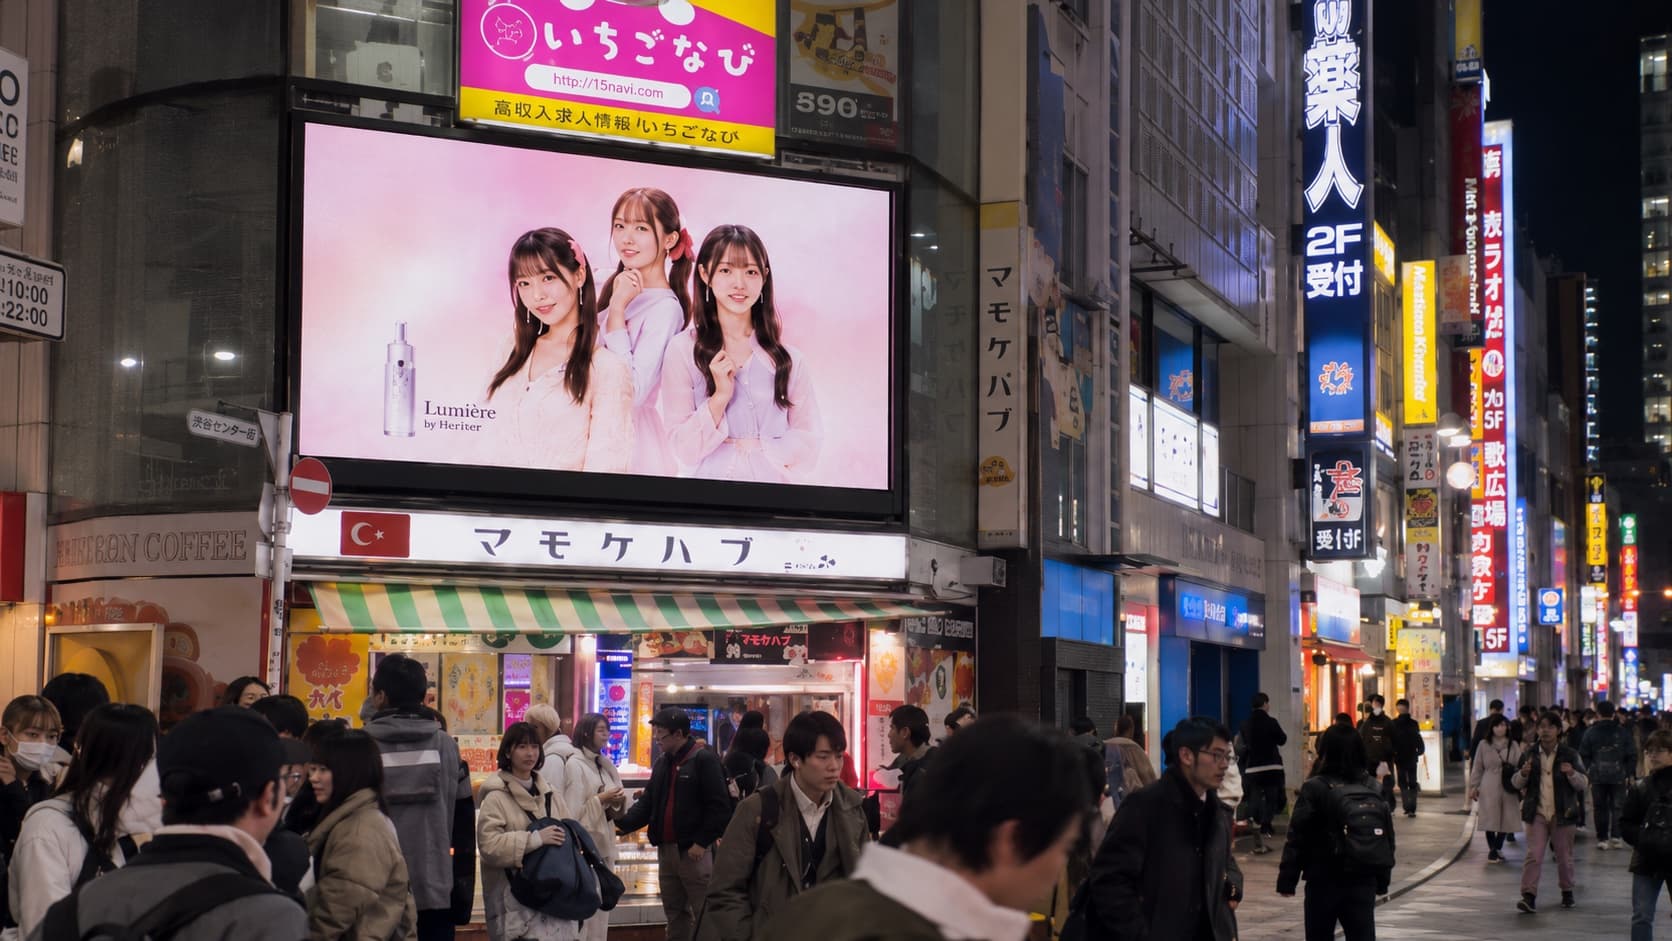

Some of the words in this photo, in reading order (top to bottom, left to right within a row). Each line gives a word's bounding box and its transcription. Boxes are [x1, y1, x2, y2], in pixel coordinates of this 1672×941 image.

[543, 21, 756, 77] いちごなび
[553, 72, 664, 100] http://15navi.com
[1306, 223, 1363, 257] 2F
[1306, 259, 1363, 299] 受付
[424, 400, 496, 420] Lumière
[424, 420, 437, 430] by
[439, 420, 482, 432] Heriter
[1485, 440, 1506, 527] 歌広場
[144, 530, 247, 562] COFFEE
[474, 527, 754, 567] マモケハブ
